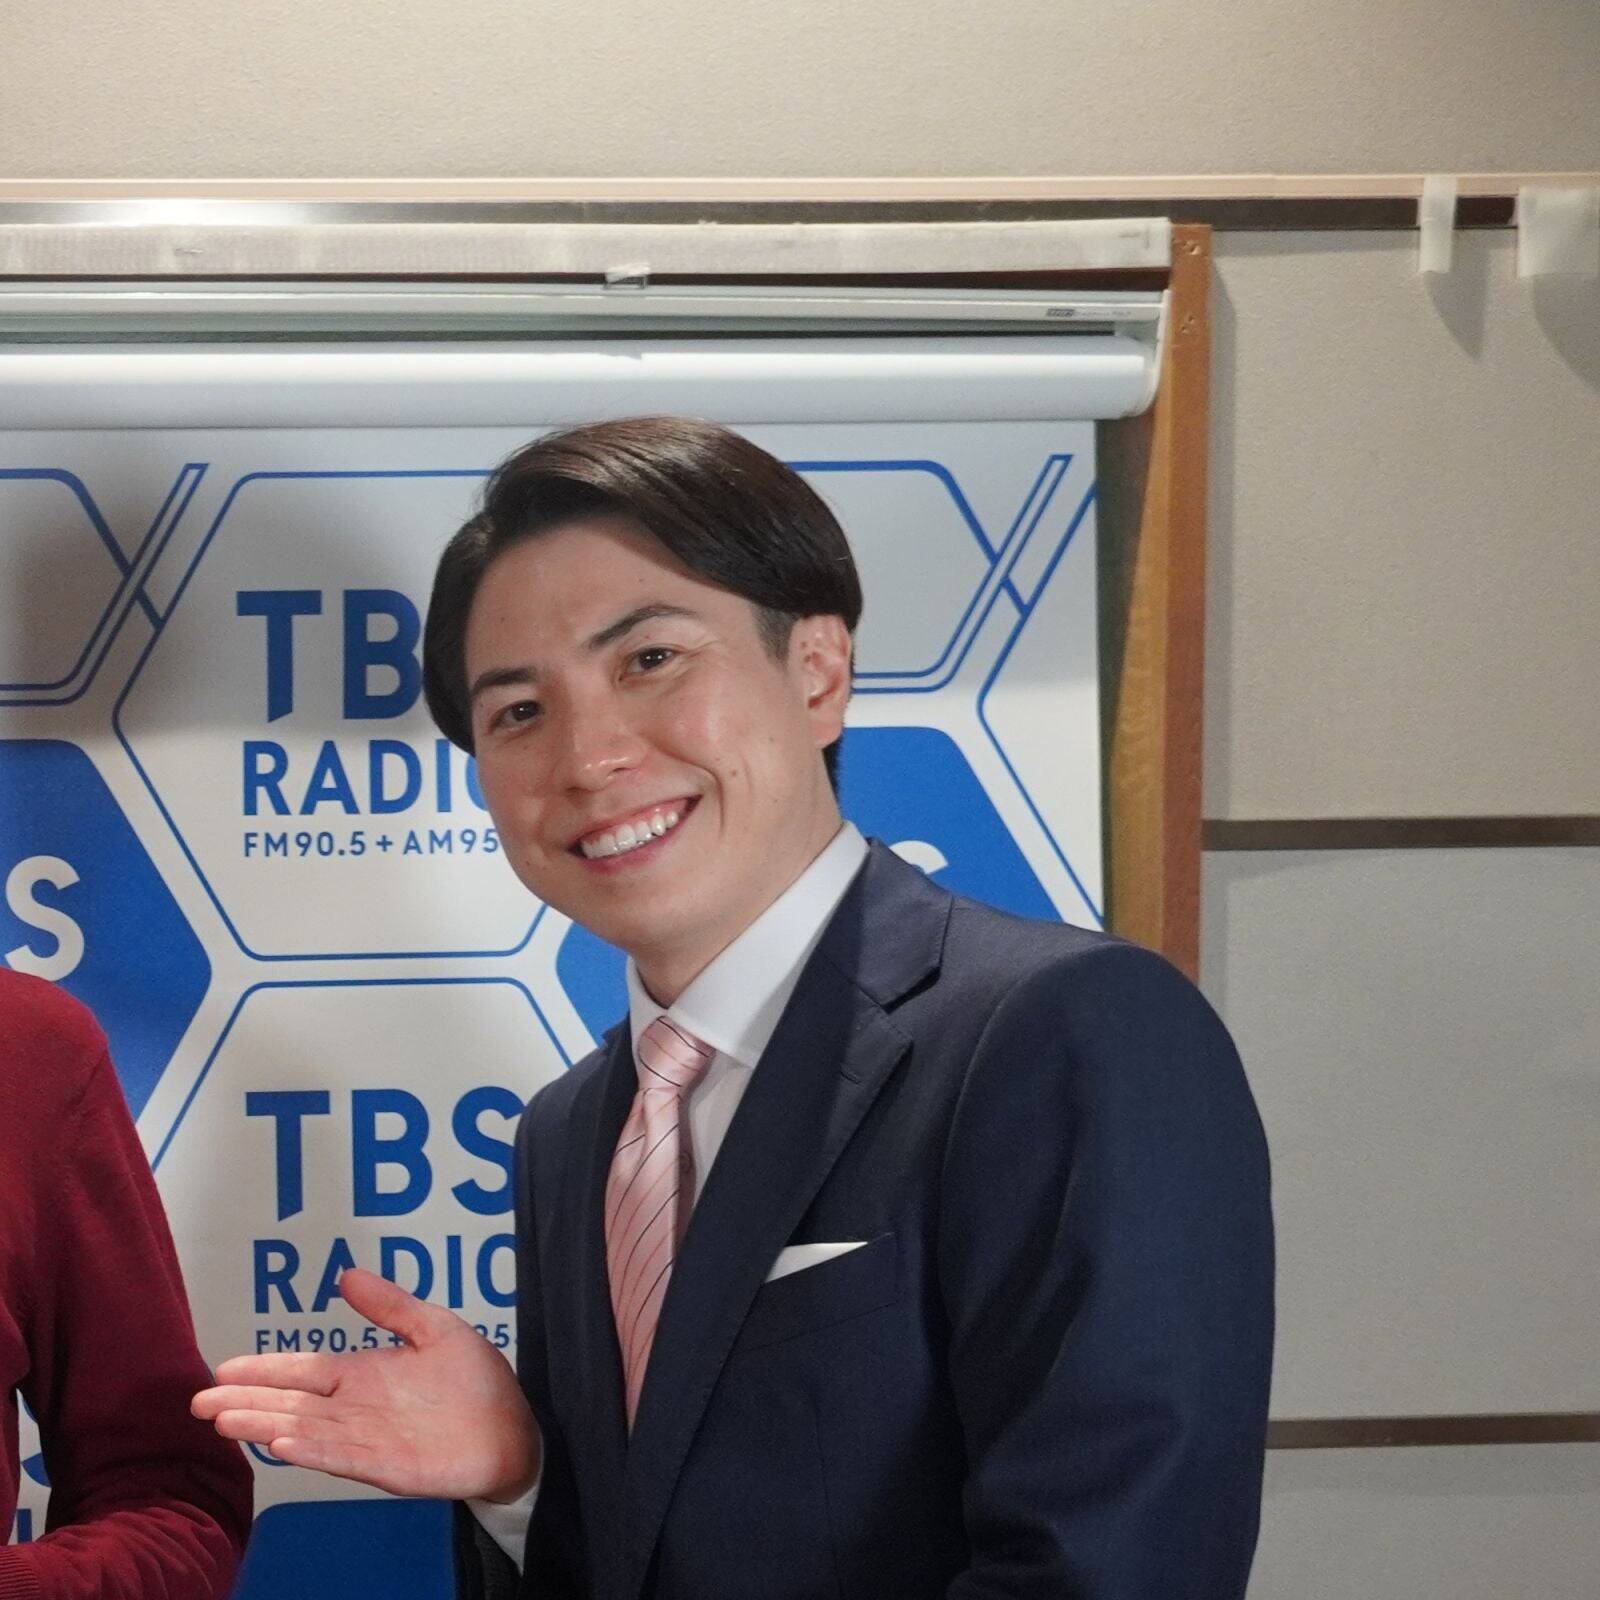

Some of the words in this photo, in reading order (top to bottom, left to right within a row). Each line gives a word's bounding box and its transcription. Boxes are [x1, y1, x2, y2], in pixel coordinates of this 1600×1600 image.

[236, 589, 422, 723] TB
[246, 1086, 527, 1221] TBS
[254, 1233, 517, 1314] RADIO
